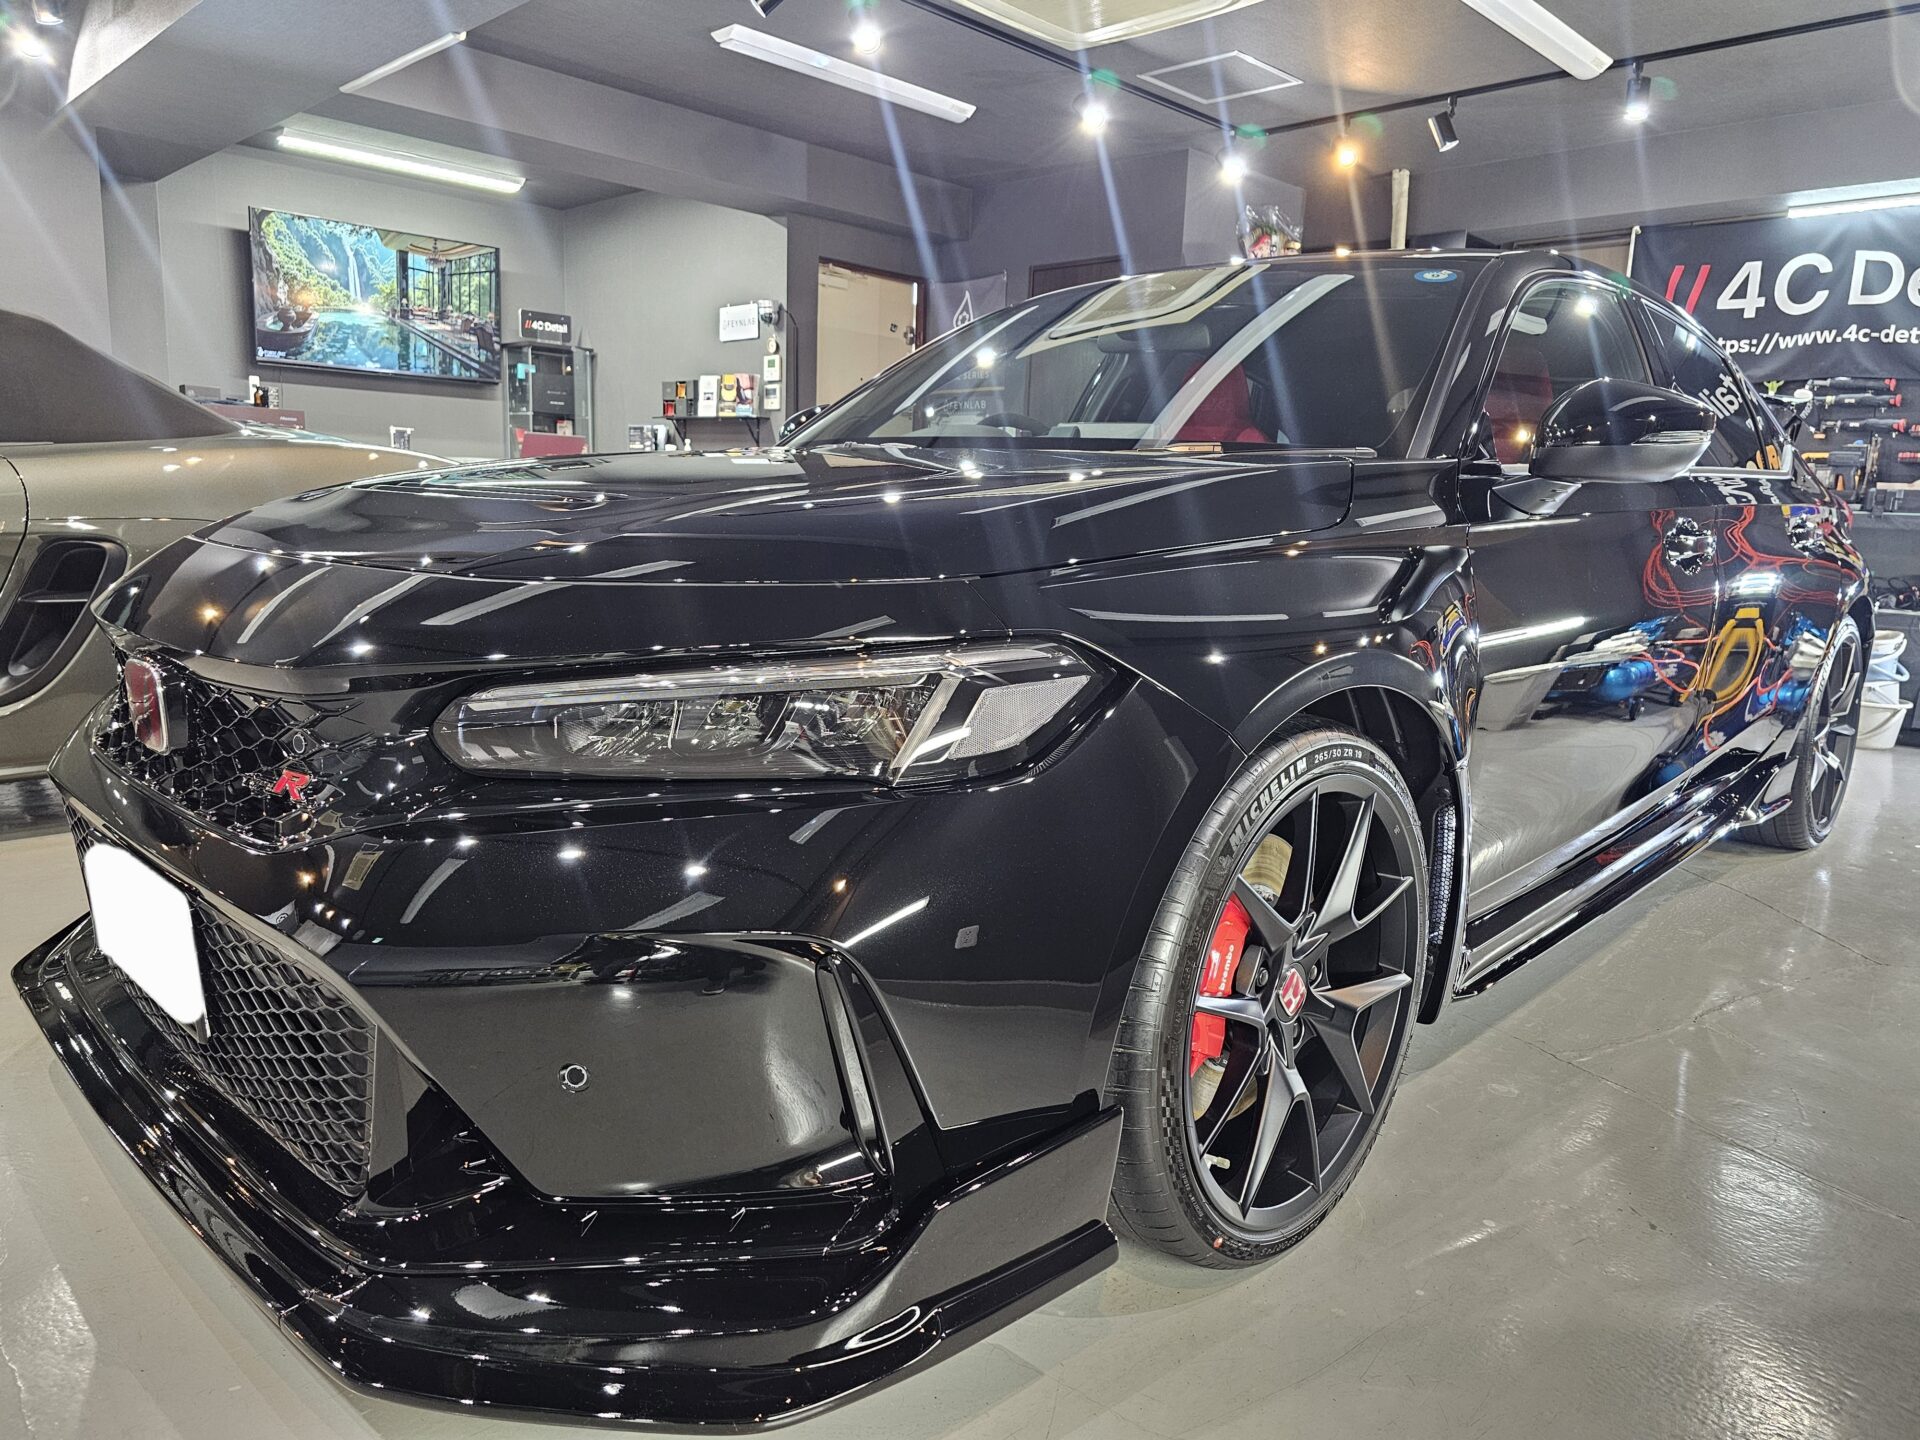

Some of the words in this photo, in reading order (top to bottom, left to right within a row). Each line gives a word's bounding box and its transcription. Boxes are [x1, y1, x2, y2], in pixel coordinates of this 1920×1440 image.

[1314, 748, 1342, 765] 265/30
[1343, 748, 1354, 758] ZR
[1355, 748, 1363, 759] 19
[1229, 756, 1308, 852] MICHELIN
[1218, 944, 1235, 991] brembo
